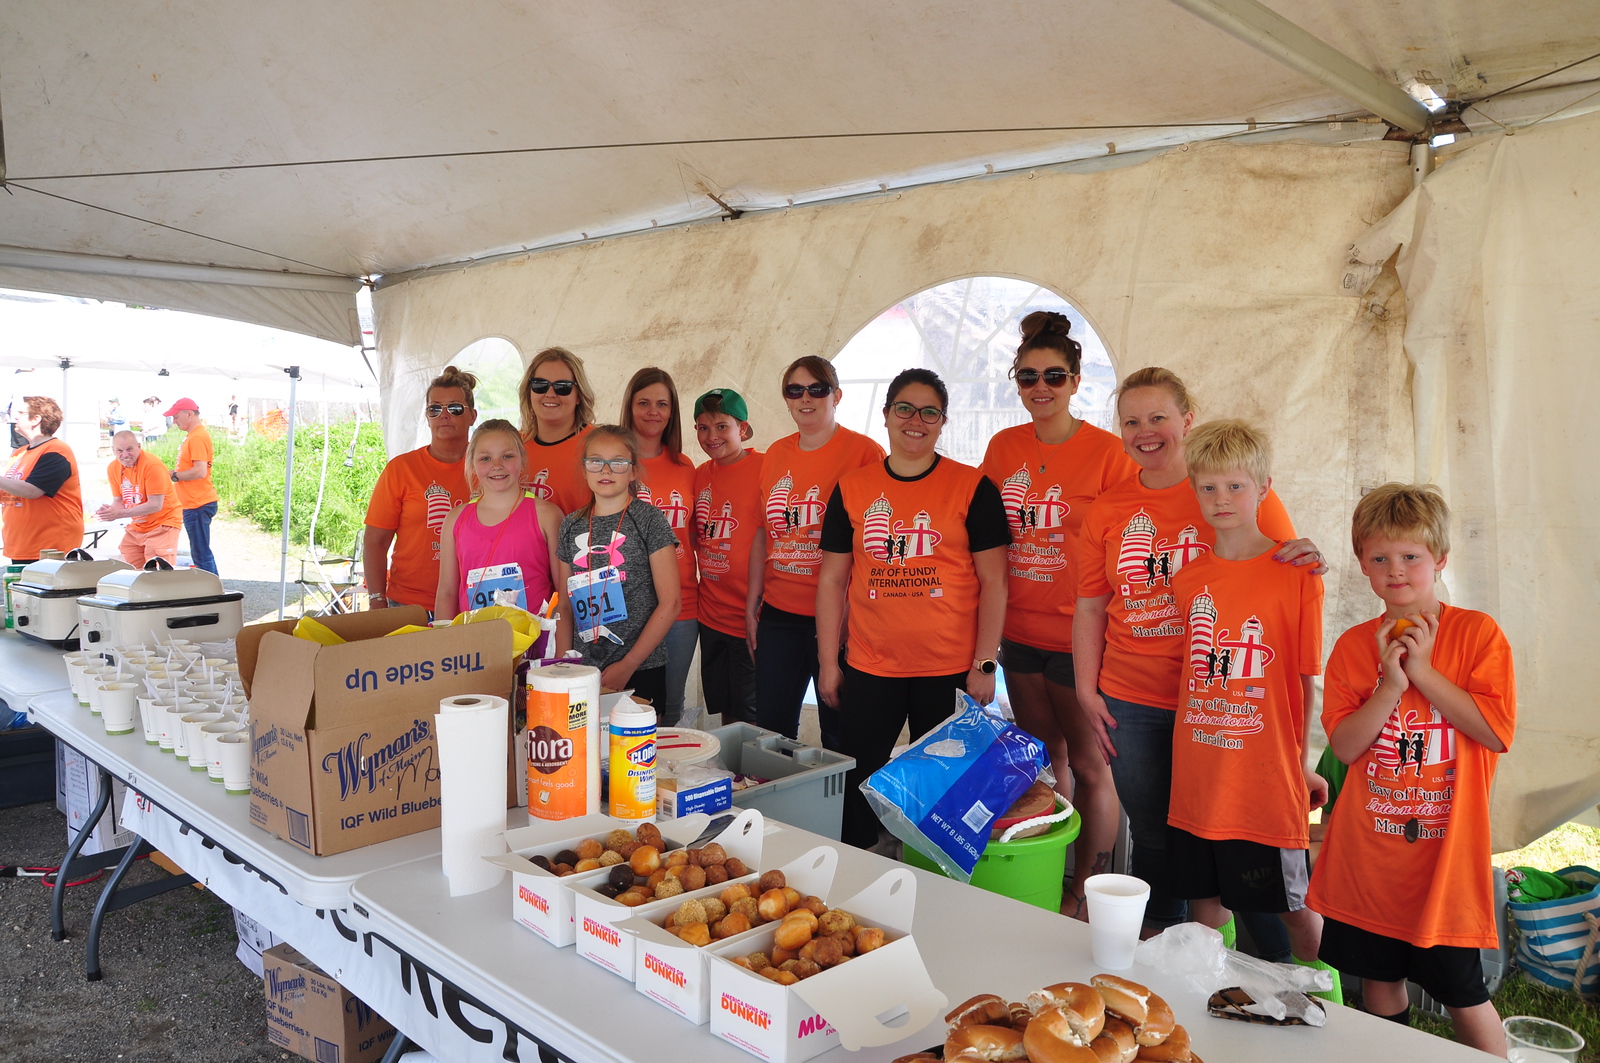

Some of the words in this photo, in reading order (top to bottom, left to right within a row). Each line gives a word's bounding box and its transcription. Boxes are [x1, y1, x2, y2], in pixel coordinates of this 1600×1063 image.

[1029, 543, 1060, 558] Fundy
[870, 567, 885, 577] BAY
[887, 569, 900, 577] OF
[902, 566, 937, 577] FUNDY
[868, 577, 942, 588] INTERNATIONAL
[576, 592, 614, 620] 951
[1124, 598, 1147, 611] Bay
[1131, 624, 1185, 637] Maratho
[385, 660, 435, 685] Side
[441, 652, 485, 675] This
[345, 668, 378, 692] Up
[568, 702, 587, 715] 70%
[568, 710, 587, 720] MORE
[1205, 698, 1219, 711] of
[1218, 698, 1258, 718] Fundy
[1183, 711, 1263, 727] International
[294, 733, 303, 742] Net
[527, 730, 573, 760] fiora
[1191, 728, 1244, 749] Marathon
[322, 719, 431, 801] Wyman's
[255, 769, 268, 787] Wild
[555, 779, 576, 790] good.
[250, 782, 279, 807] lueberries
[685, 794, 694, 802] 500
[693, 788, 715, 800] Disposable
[714, 785, 727, 793] Gloves
[1367, 779, 1391, 800] Bay
[340, 814, 365, 830] IQF
[368, 806, 397, 824] Wild
[931, 813, 943, 824] NET
[941, 821, 952, 832] WT
[953, 833, 966, 845] LBS
[519, 889, 550, 915] DUNKIN'
[583, 920, 622, 948] DUNKIN'
[584, 916, 601, 928] AMERICA
[600, 923, 612, 934] RUNS
[644, 956, 687, 988] DUNKIN'
[645, 952, 664, 966] AMERICA
[664, 962, 676, 973] RUNS
[264, 966, 306, 1003] Wyman's
[311, 986, 320, 995] 13.6
[320, 990, 328, 998] Kg
[317, 981, 326, 990] Lbs.
[327, 985, 336, 993] Net
[278, 1004, 293, 1019] Wild
[721, 996, 771, 1030] DUNKIN'
[722, 992, 744, 1006] AMERICA
[744, 1002, 759, 1014] RUNS
[759, 1009, 768, 1018] ON
[266, 1010, 305, 1036] Blueberries
[358, 1037, 375, 1052] IQF
